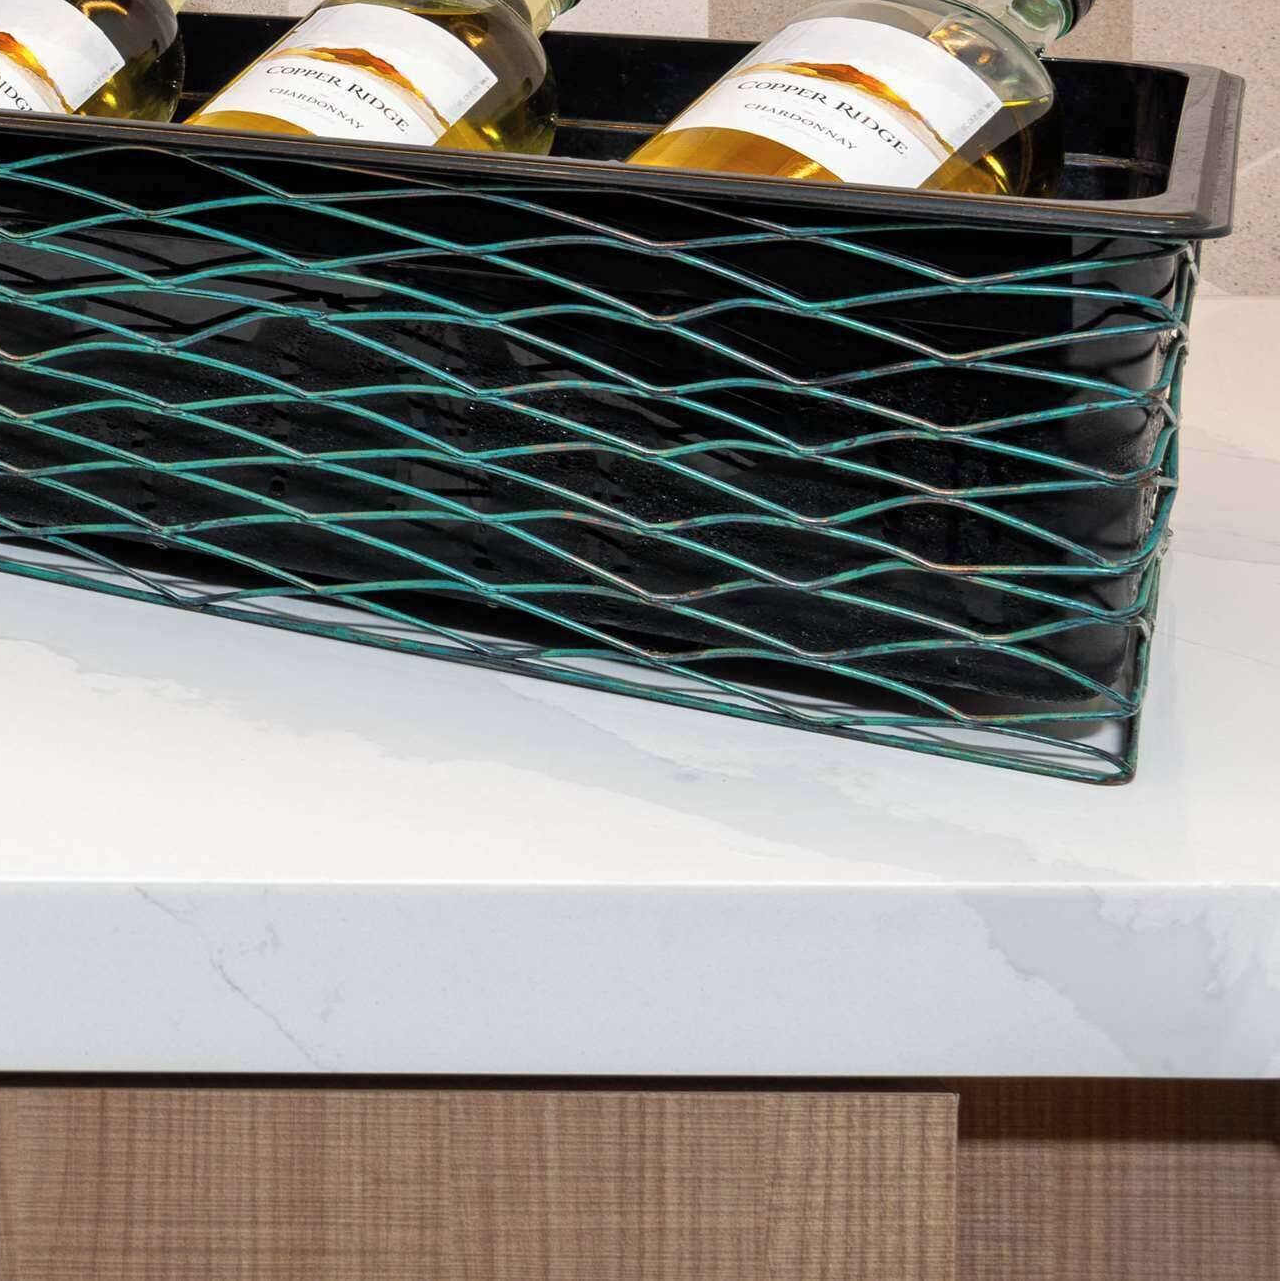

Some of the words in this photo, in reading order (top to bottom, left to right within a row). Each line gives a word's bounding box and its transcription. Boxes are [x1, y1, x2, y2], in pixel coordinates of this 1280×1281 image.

[266, 65, 341, 88] COPPER
[347, 83, 410, 132] RIDGE
[269, 87, 364, 129] CHARDONNAY
[737, 80, 828, 106] COPPER
[835, 101, 908, 155] RIDGE
[744, 102, 858, 150] CHARDONNAY
